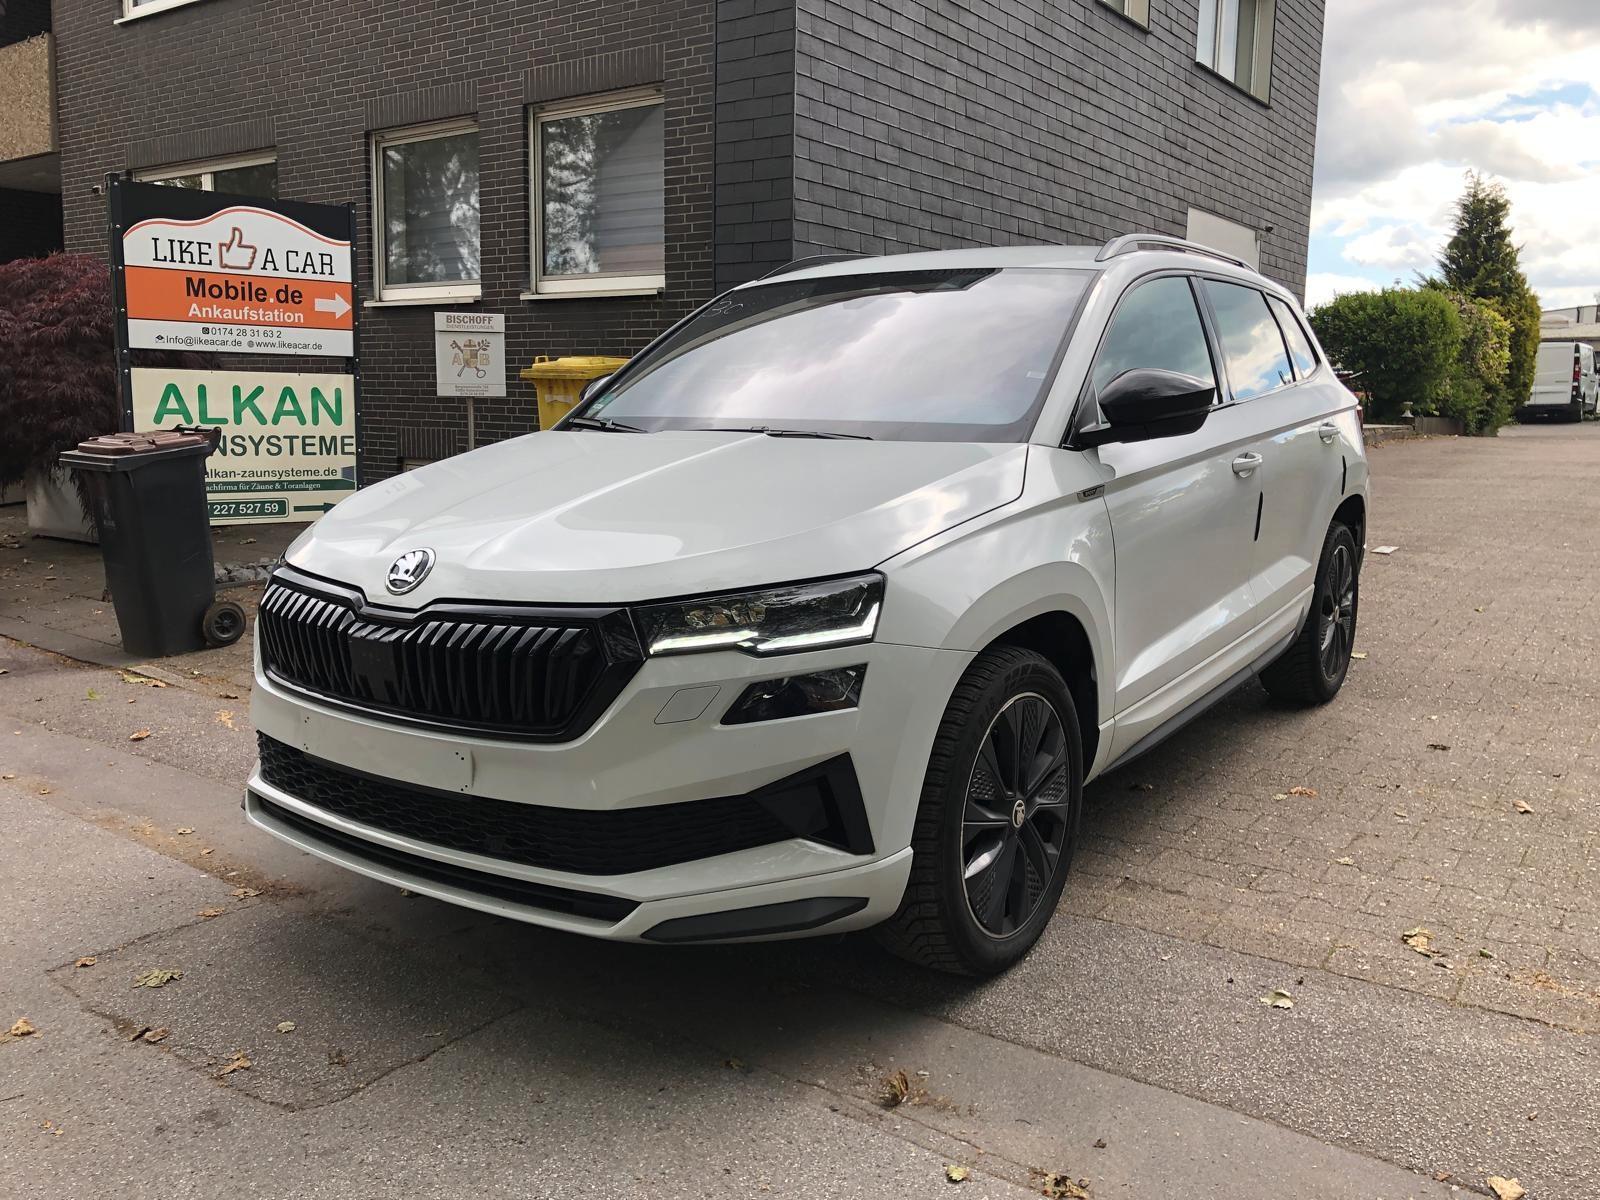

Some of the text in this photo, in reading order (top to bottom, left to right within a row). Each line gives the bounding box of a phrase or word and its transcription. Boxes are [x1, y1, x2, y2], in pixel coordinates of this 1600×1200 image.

[151, 237, 335, 276] LIKE A CAR
[186, 276, 304, 305] Mobile.de
[188, 303, 304, 323] Ankaufstation
[446, 315, 494, 325] BISCHOFF
[211, 327, 282, 339] 0174 28 31 63 2
[166, 335, 242, 347] Info@likeacar.de
[255, 340, 323, 351] www.likeacar.de
[153, 382, 343, 427] ALKAN
[209, 434, 356, 457] NSYSTEME
[205, 467, 338, 481] alkan-zaunsysteme.de
[205, 482, 237, 491] achfirma
[238, 482, 250, 491] für
[251, 482, 273, 490] Zäune
[274, 482, 281, 490] &
[213, 504, 236, 515] 227
[239, 503, 262, 514] 527
[264, 502, 279, 514] 59
